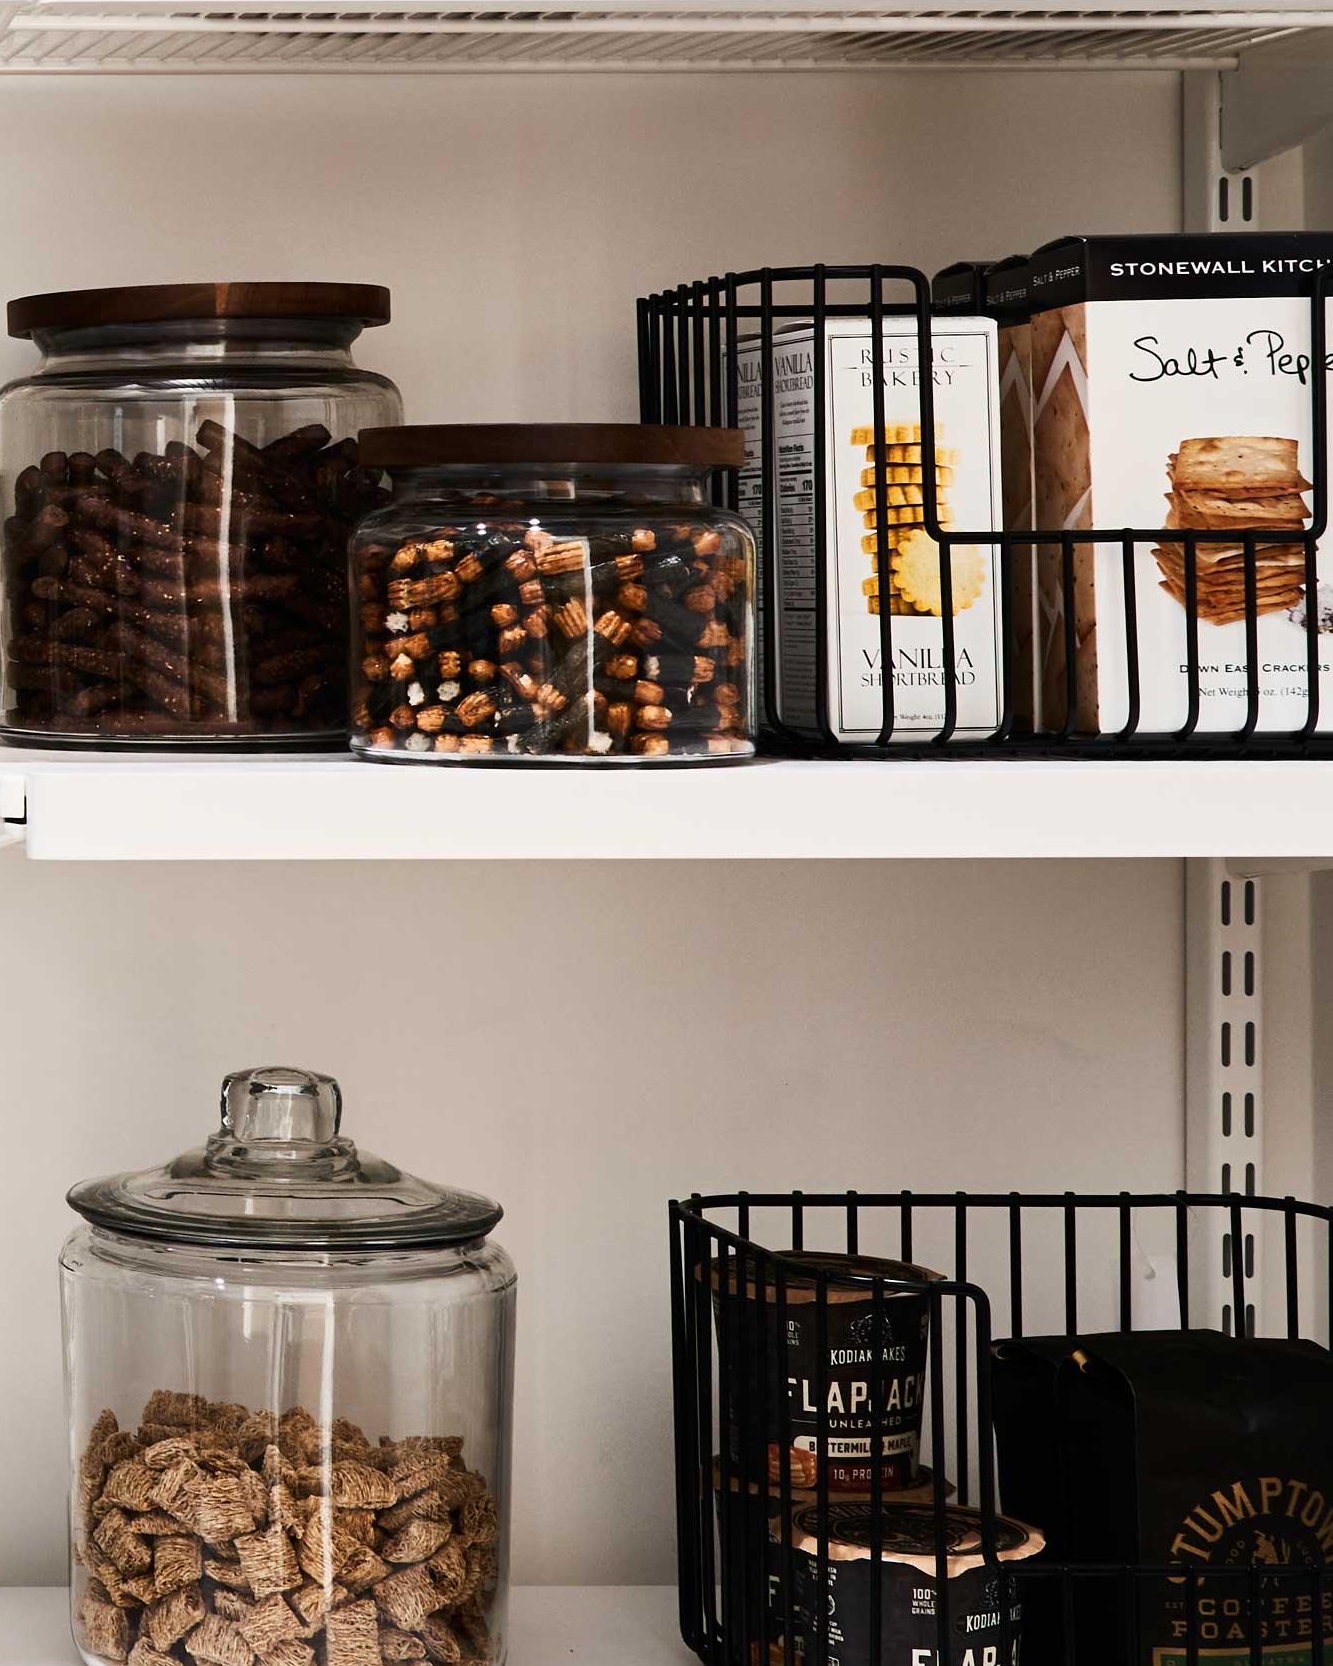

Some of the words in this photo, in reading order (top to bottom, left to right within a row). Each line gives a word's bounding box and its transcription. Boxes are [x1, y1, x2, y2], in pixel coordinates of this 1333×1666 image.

[1033, 274, 1048, 287] SALT
[1055, 266, 1081, 280] PEPPER
[1110, 260, 1255, 277] STONEWALL
[775, 352, 813, 377] VANILLA
[1129, 336, 1227, 382] Salt
[1233, 346, 1249, 375] &
[861, 370, 954, 387] BKERY
[862, 648, 973, 669] VNILA
[1262, 663, 1330, 672] CRACKRS
[830, 1349, 873, 1366] KODIAK
[829, 1416, 902, 1428] UNLEAHED
[912, 1607, 936, 1615] GRAINS
[1198, 1593, 1333, 1616] COFEE
